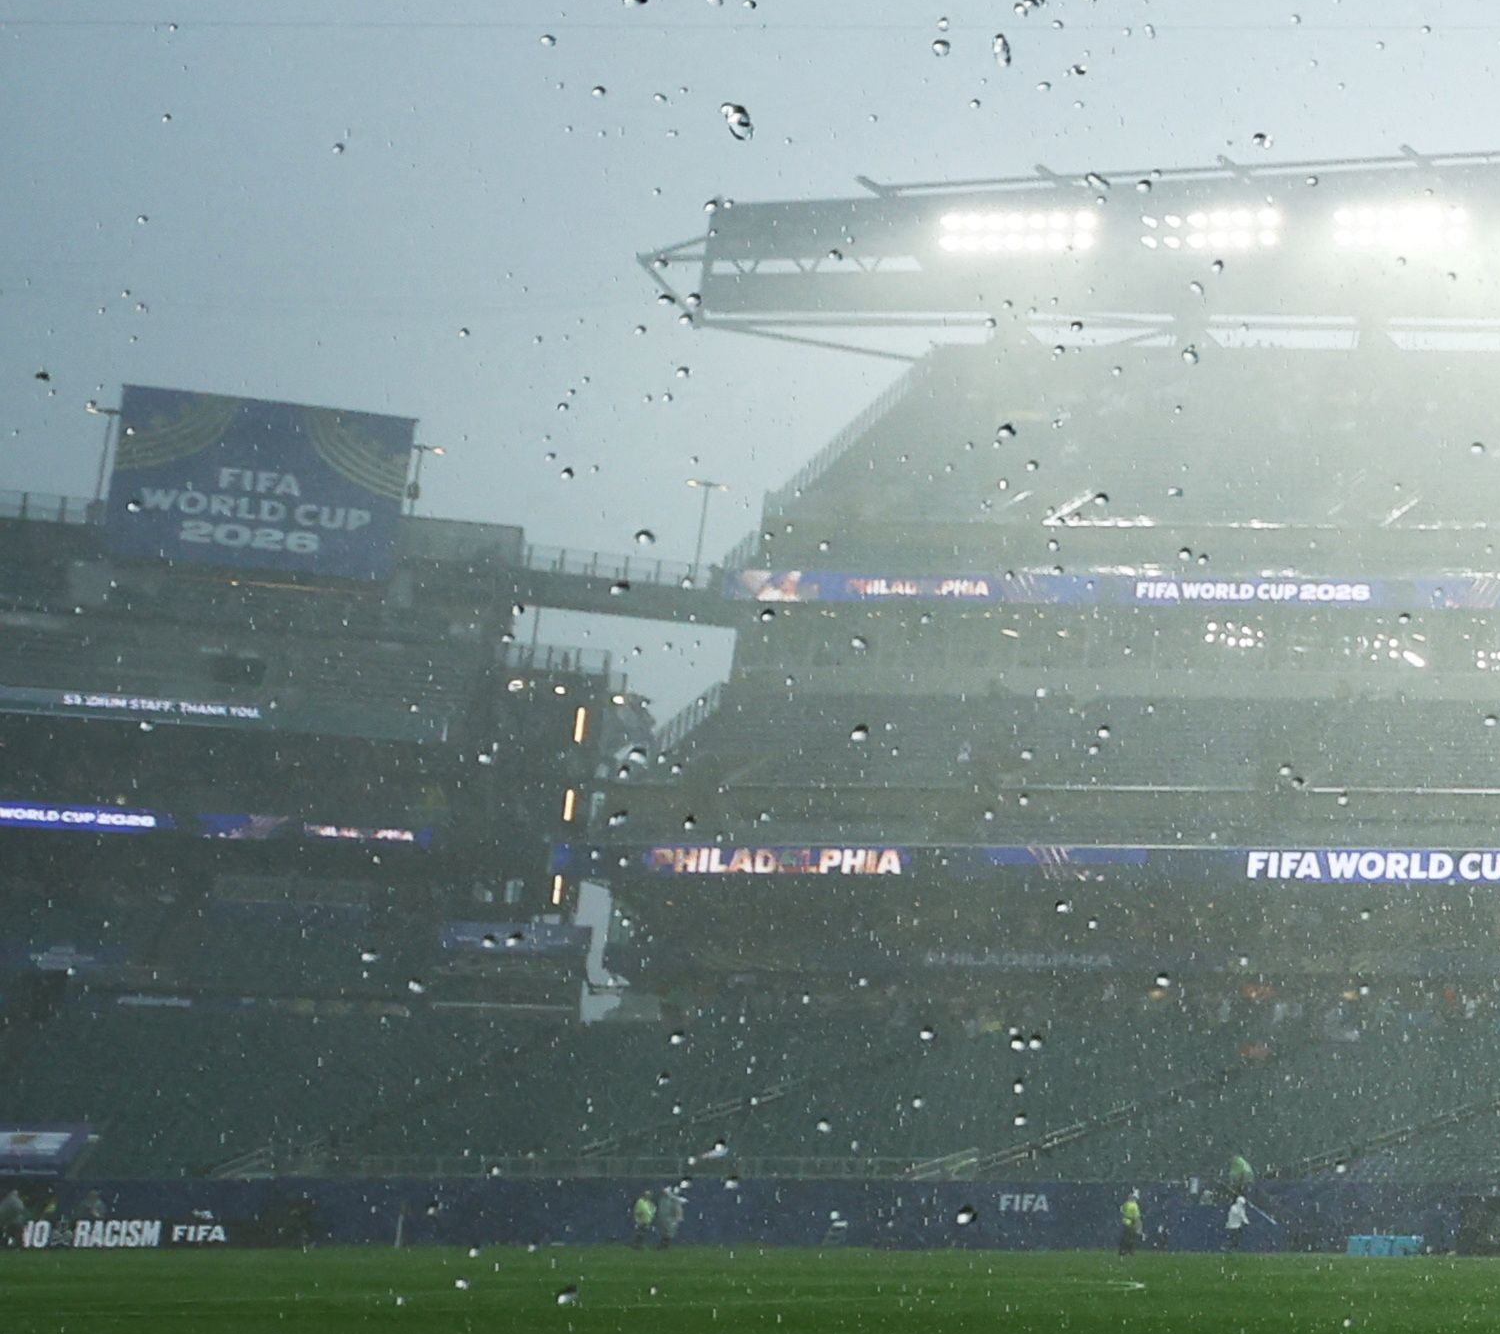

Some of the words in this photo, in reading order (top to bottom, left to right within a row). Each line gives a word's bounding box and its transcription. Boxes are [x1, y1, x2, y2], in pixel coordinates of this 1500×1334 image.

[219, 468, 299, 496] FIFA
[142, 487, 285, 521] WORLD
[295, 504, 371, 530] CUP
[180, 520, 319, 553] 2026
[1136, 582, 1179, 599] FIFA
[1183, 583, 1254, 600] WORLD
[1257, 584, 1298, 600] CUP
[1299, 584, 1370, 601] 2026
[61, 810, 96, 823] CUP
[1247, 852, 1321, 878] FIFA
[1327, 852, 1454, 880] WORLD
[1000, 1194, 1049, 1212] FIFA
[73, 1220, 161, 1248] RACISM
[171, 1225, 226, 1242] FIFA
